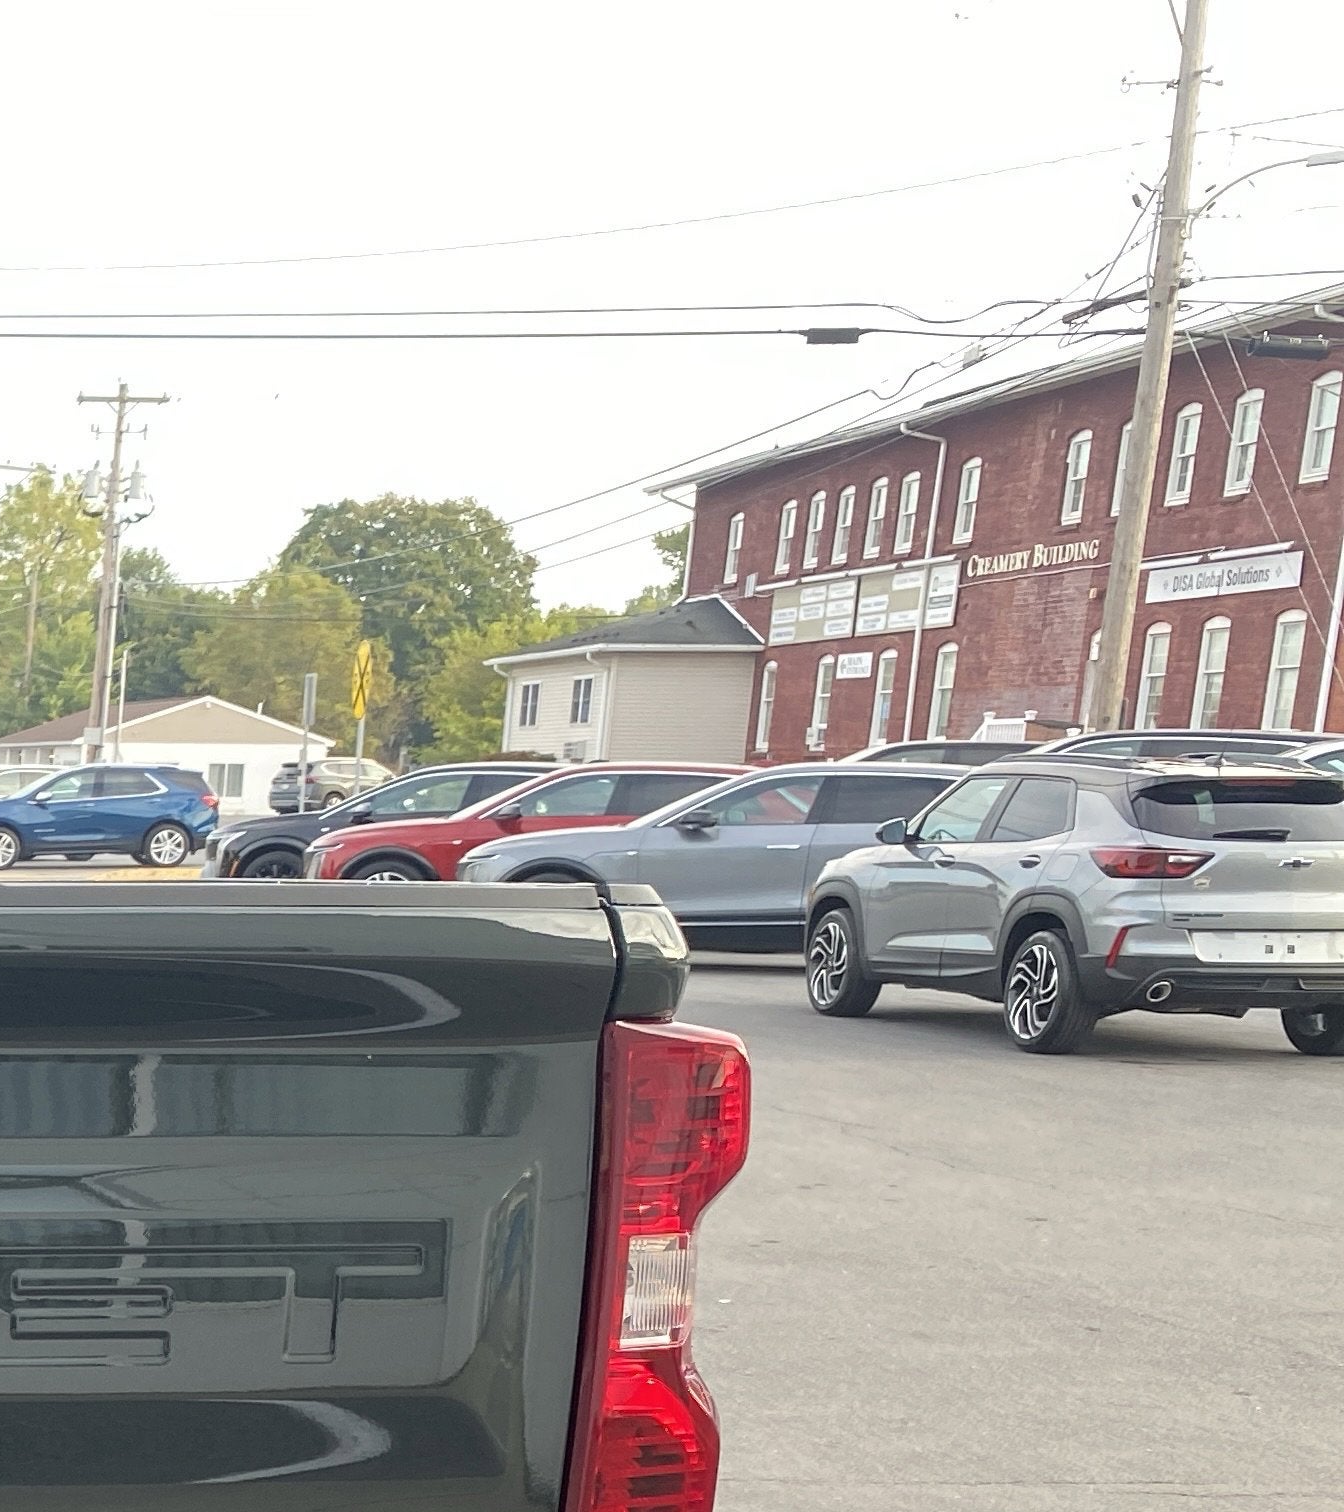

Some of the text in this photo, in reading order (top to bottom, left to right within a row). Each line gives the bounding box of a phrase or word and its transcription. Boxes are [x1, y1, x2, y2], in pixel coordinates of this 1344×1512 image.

[1172, 565, 1271, 593] DISA Global Solutions
